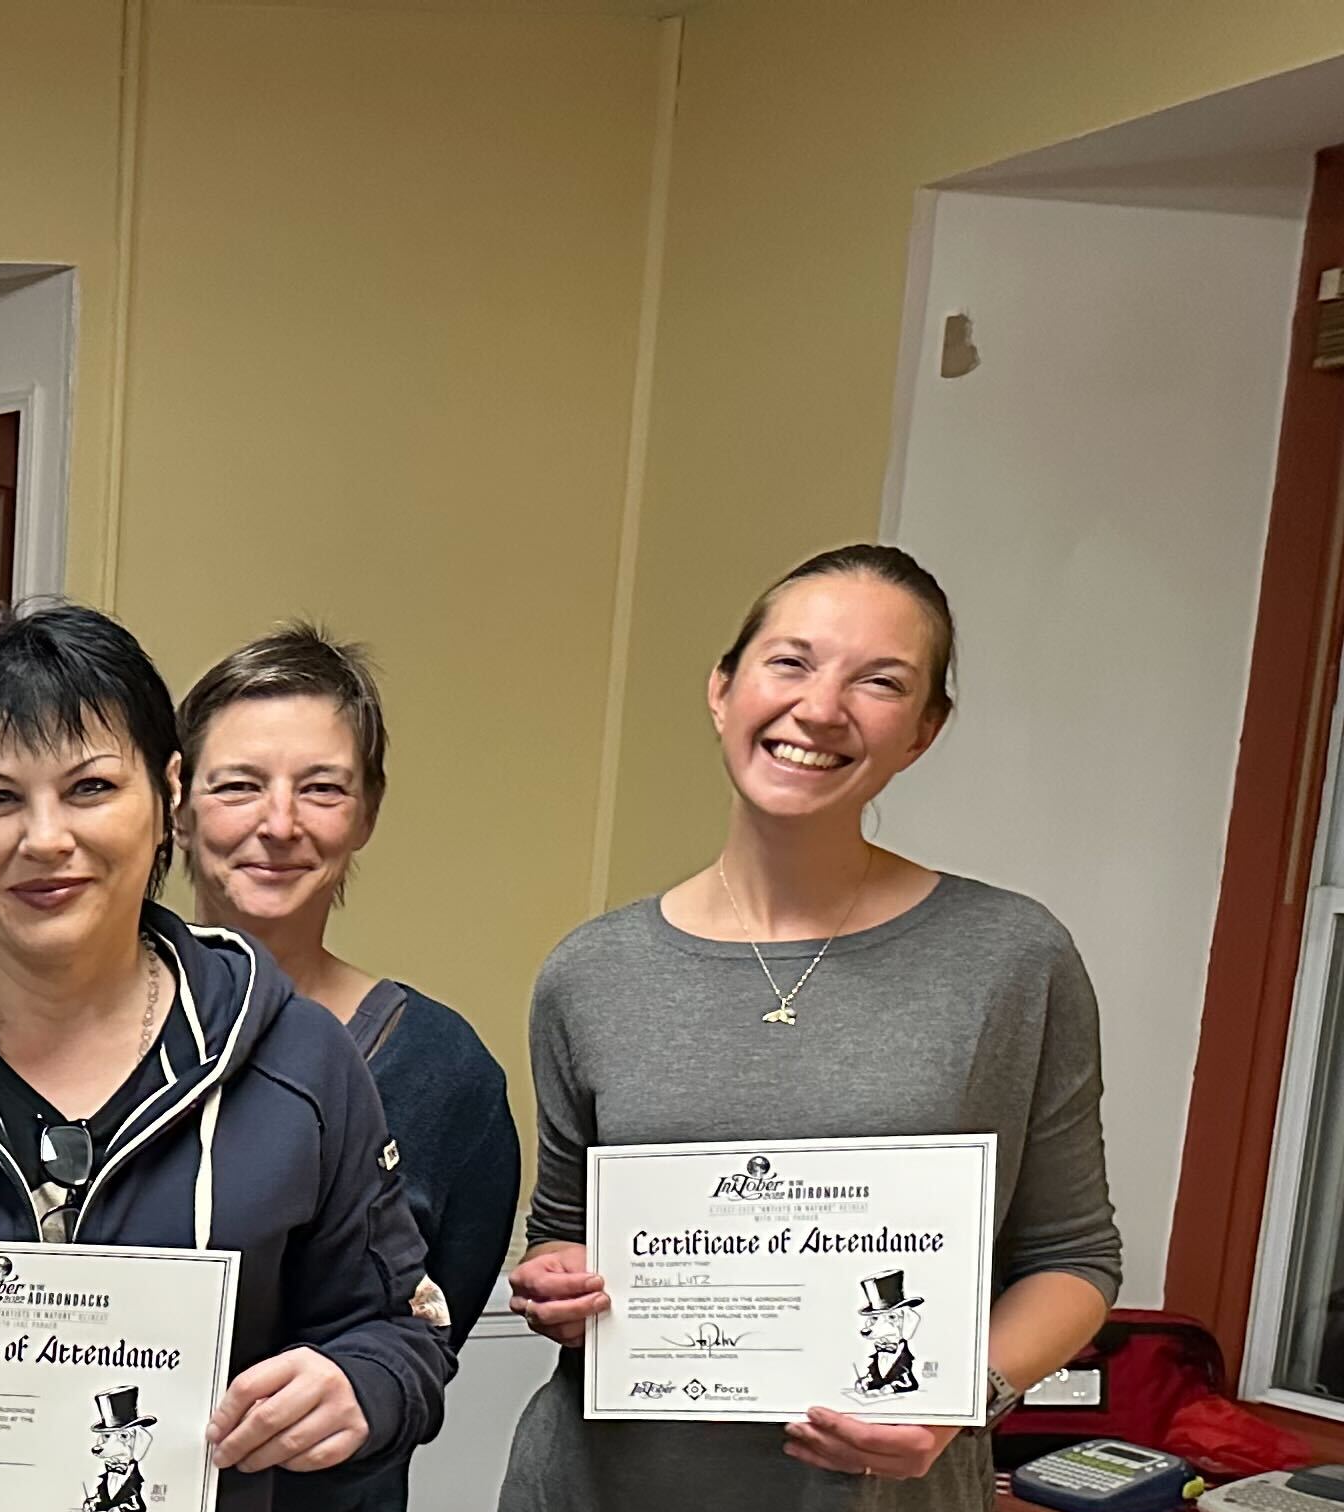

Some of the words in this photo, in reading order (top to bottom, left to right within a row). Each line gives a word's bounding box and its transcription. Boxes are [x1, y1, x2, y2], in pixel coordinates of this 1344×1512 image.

[709, 1172, 785, 1201] InkTober
[787, 1186, 870, 1199] ADIRONDACKS
[632, 1229, 759, 1256] Certificate
[768, 1227, 792, 1255] of
[799, 1226, 944, 1255] Attendance
[678, 1271, 711, 1287] LUTZ
[26, 1291, 110, 1308] ADIRONDACKS
[5, 1334, 30, 1362] of
[36, 1335, 181, 1370] Attendance
[714, 1383, 749, 1394] Focus
